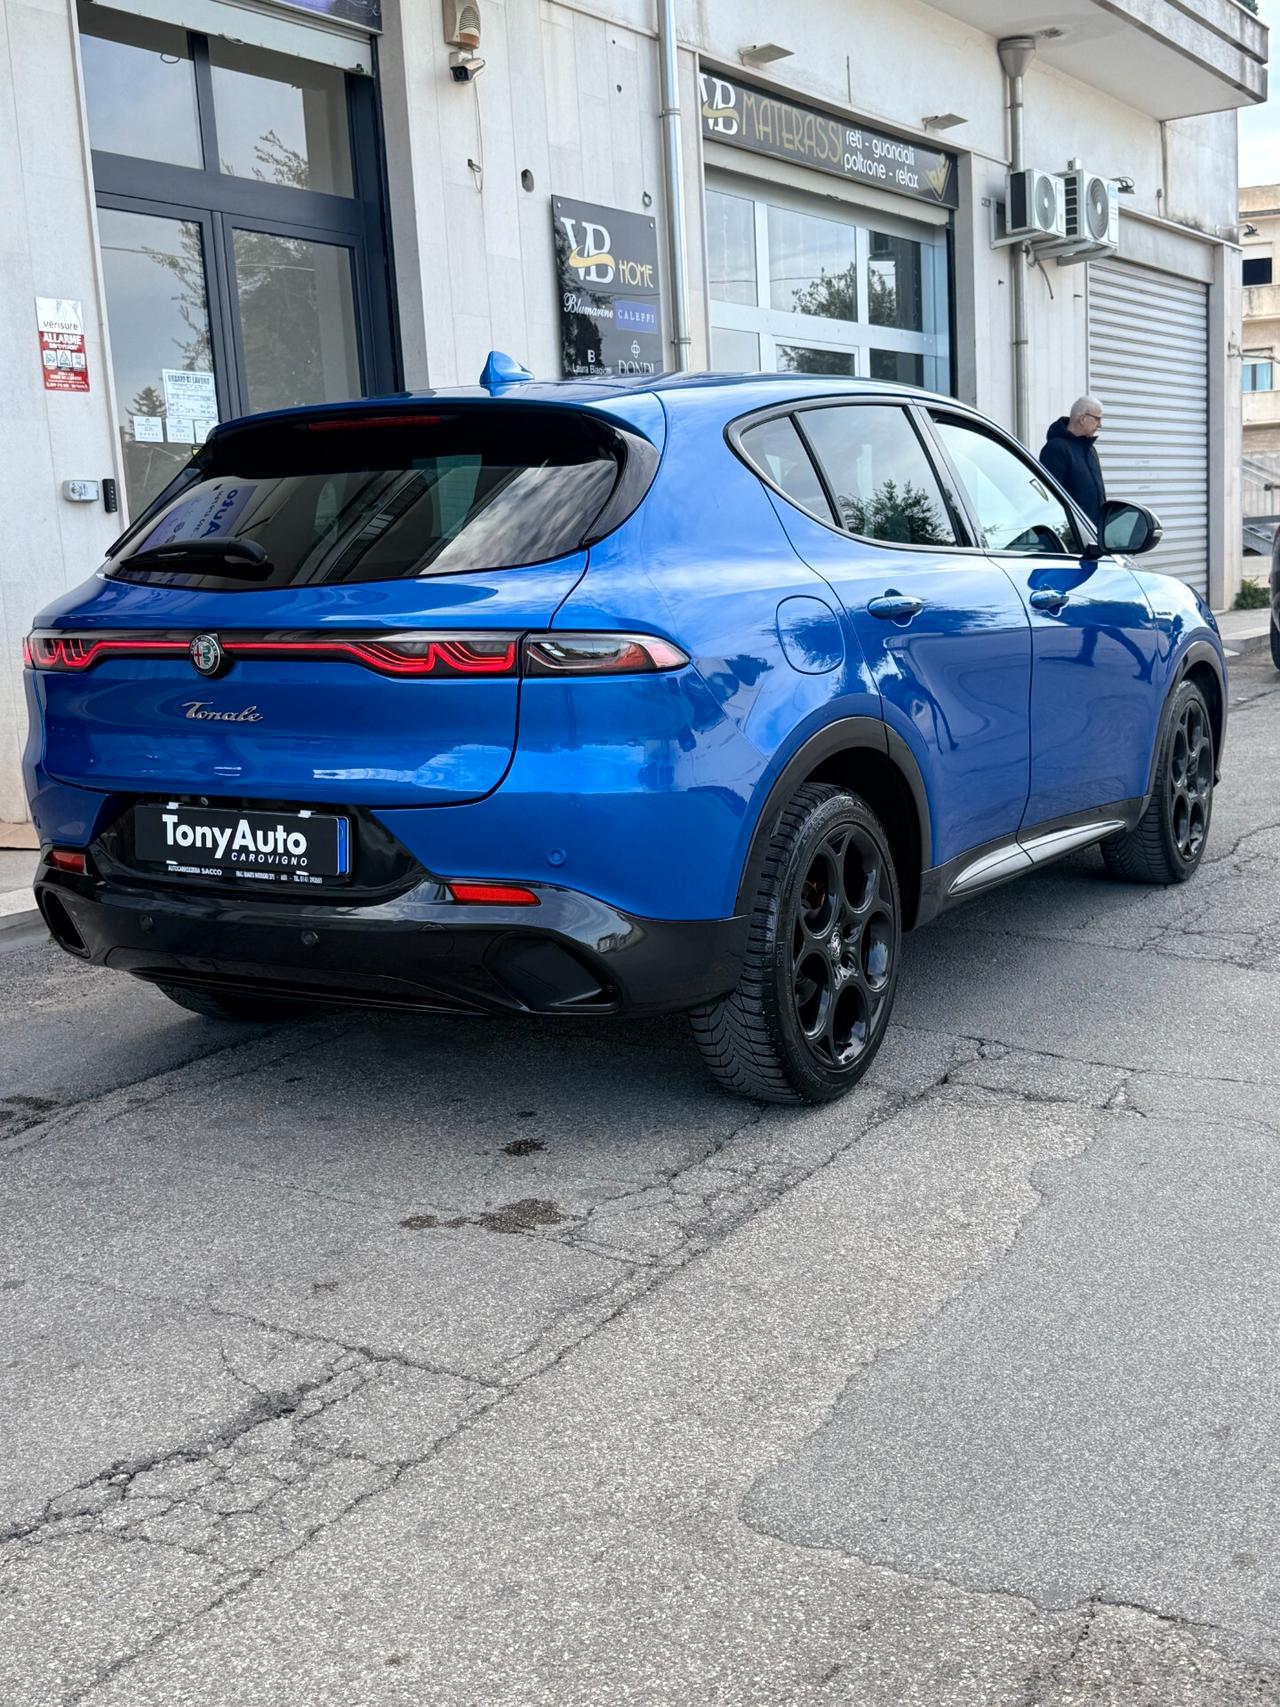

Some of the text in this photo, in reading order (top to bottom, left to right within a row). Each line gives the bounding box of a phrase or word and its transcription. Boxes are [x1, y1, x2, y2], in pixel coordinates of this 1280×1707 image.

[742, 93, 843, 166] MATERASSI
[846, 130, 862, 150] reti
[872, 139, 915, 166] guanciali
[844, 152, 886, 179] poltrone
[895, 167, 919, 188] relax
[619, 260, 654, 288] HOME
[563, 292, 614, 319] Blumarine
[43, 320, 79, 331] verisure
[617, 310, 655, 324] CALEFFI
[43, 332, 82, 345] ALLARME
[618, 359, 655, 375] DONDI
[181, 701, 263, 722] Tonale
[162, 814, 307, 859] TonyAuto
[231, 852, 308, 867] CAROVIGNO
[201, 867, 223, 876] SACCO
